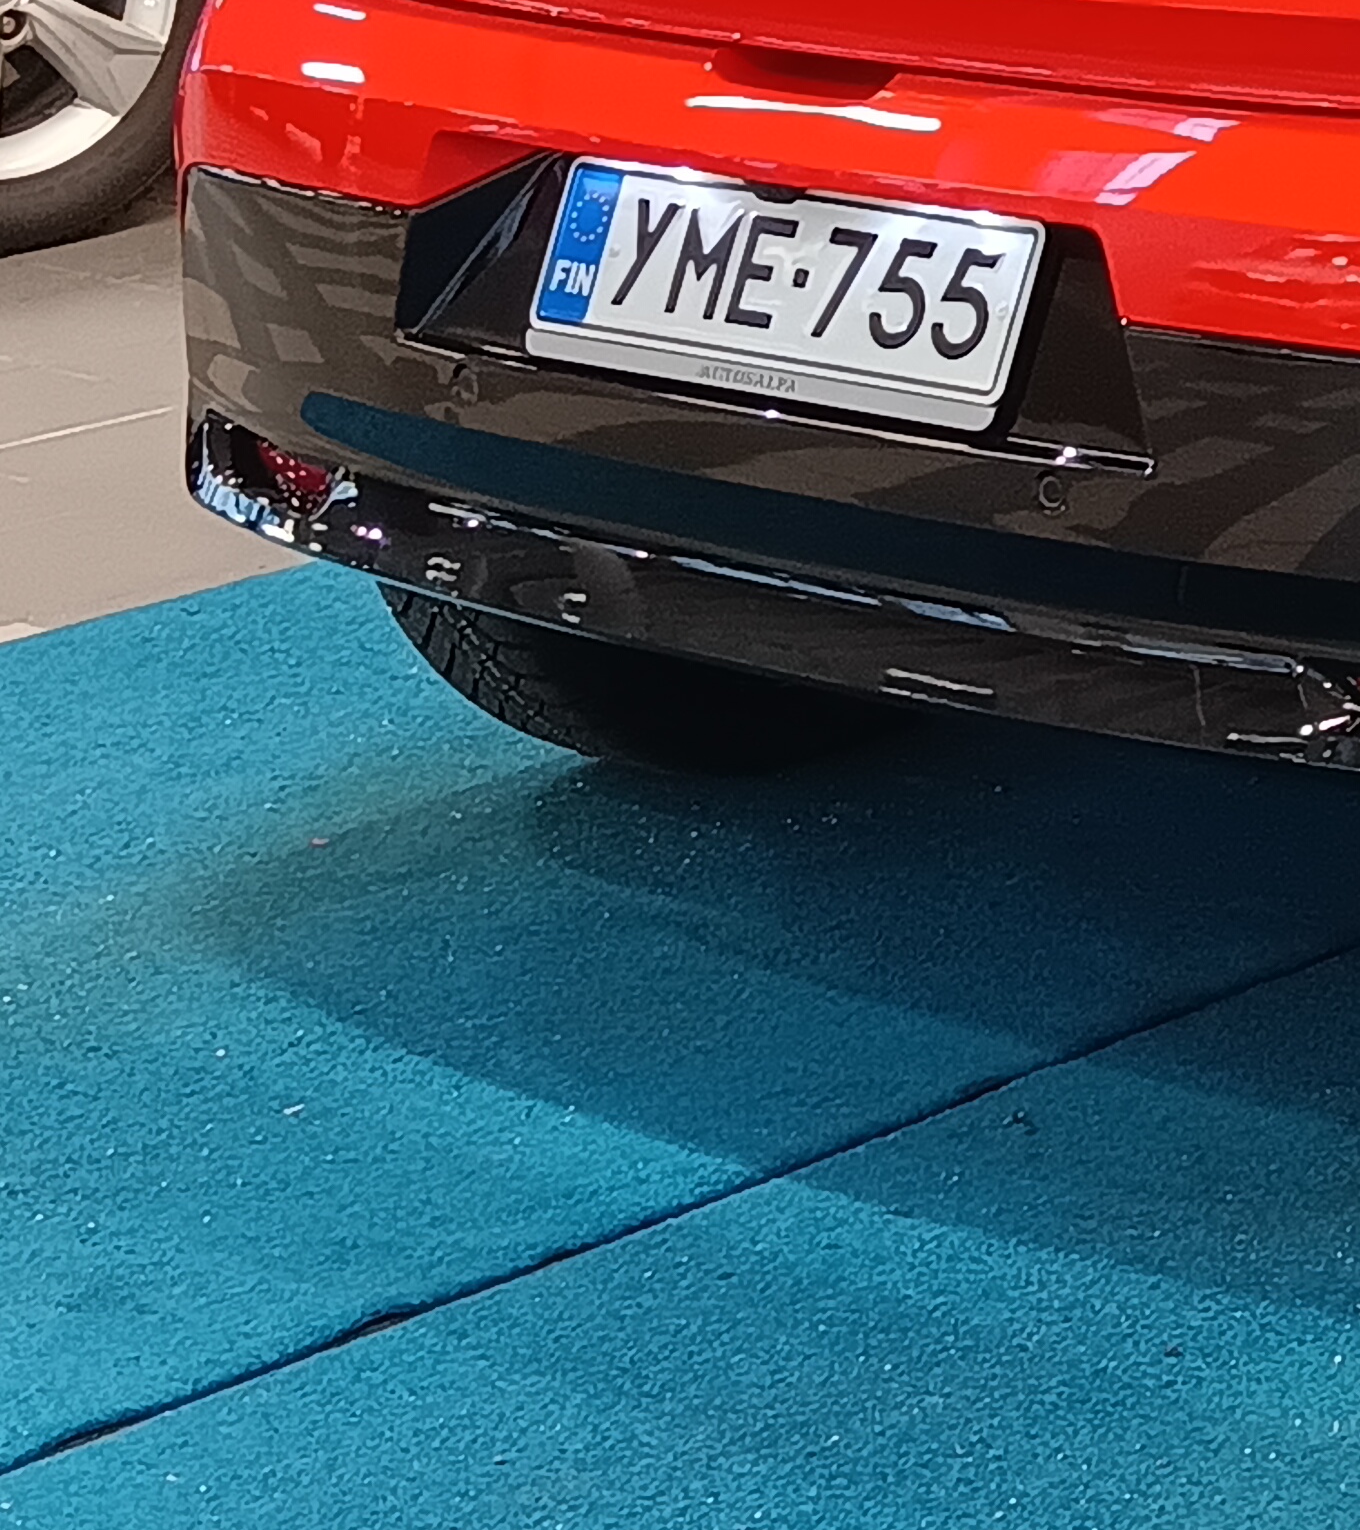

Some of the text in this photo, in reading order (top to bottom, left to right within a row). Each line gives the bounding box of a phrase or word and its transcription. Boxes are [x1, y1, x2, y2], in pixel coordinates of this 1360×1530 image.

[548, 258, 597, 298] FIN
[610, 198, 1006, 360] YME-755
[695, 364, 797, 393] AUTOSALPA
